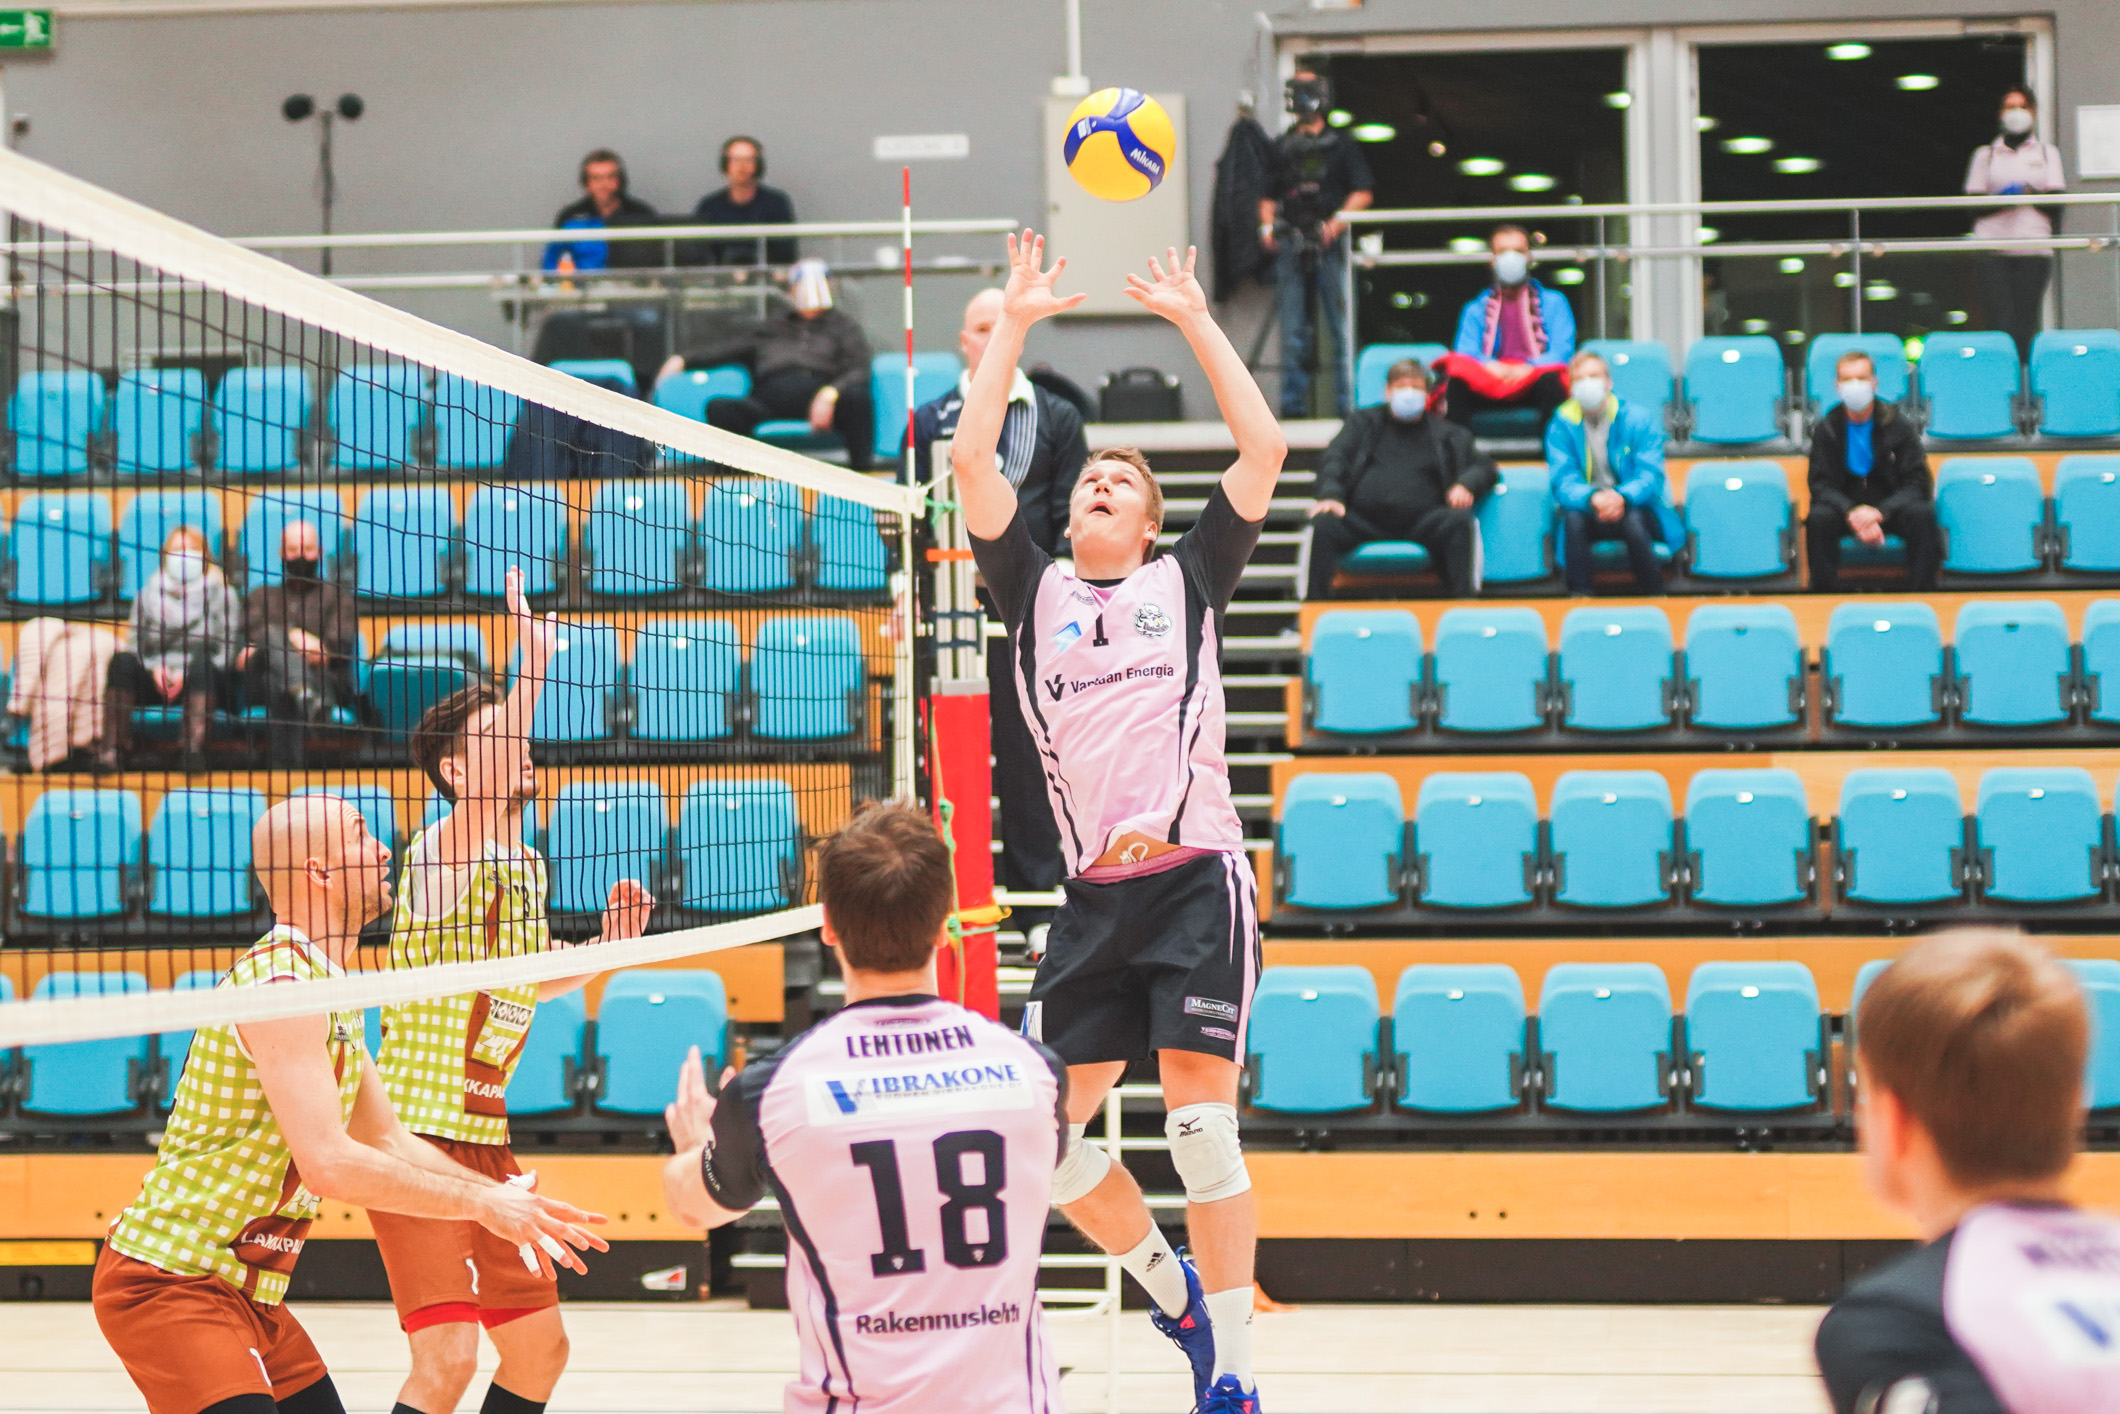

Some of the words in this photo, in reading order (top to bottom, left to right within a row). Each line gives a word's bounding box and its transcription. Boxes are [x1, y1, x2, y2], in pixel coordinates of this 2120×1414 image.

[1092, 612, 1109, 647] 1
[1126, 663, 1174, 678] Energia
[846, 1025, 975, 1058] LEHTONEN
[850, 1130, 1009, 1279] 18
